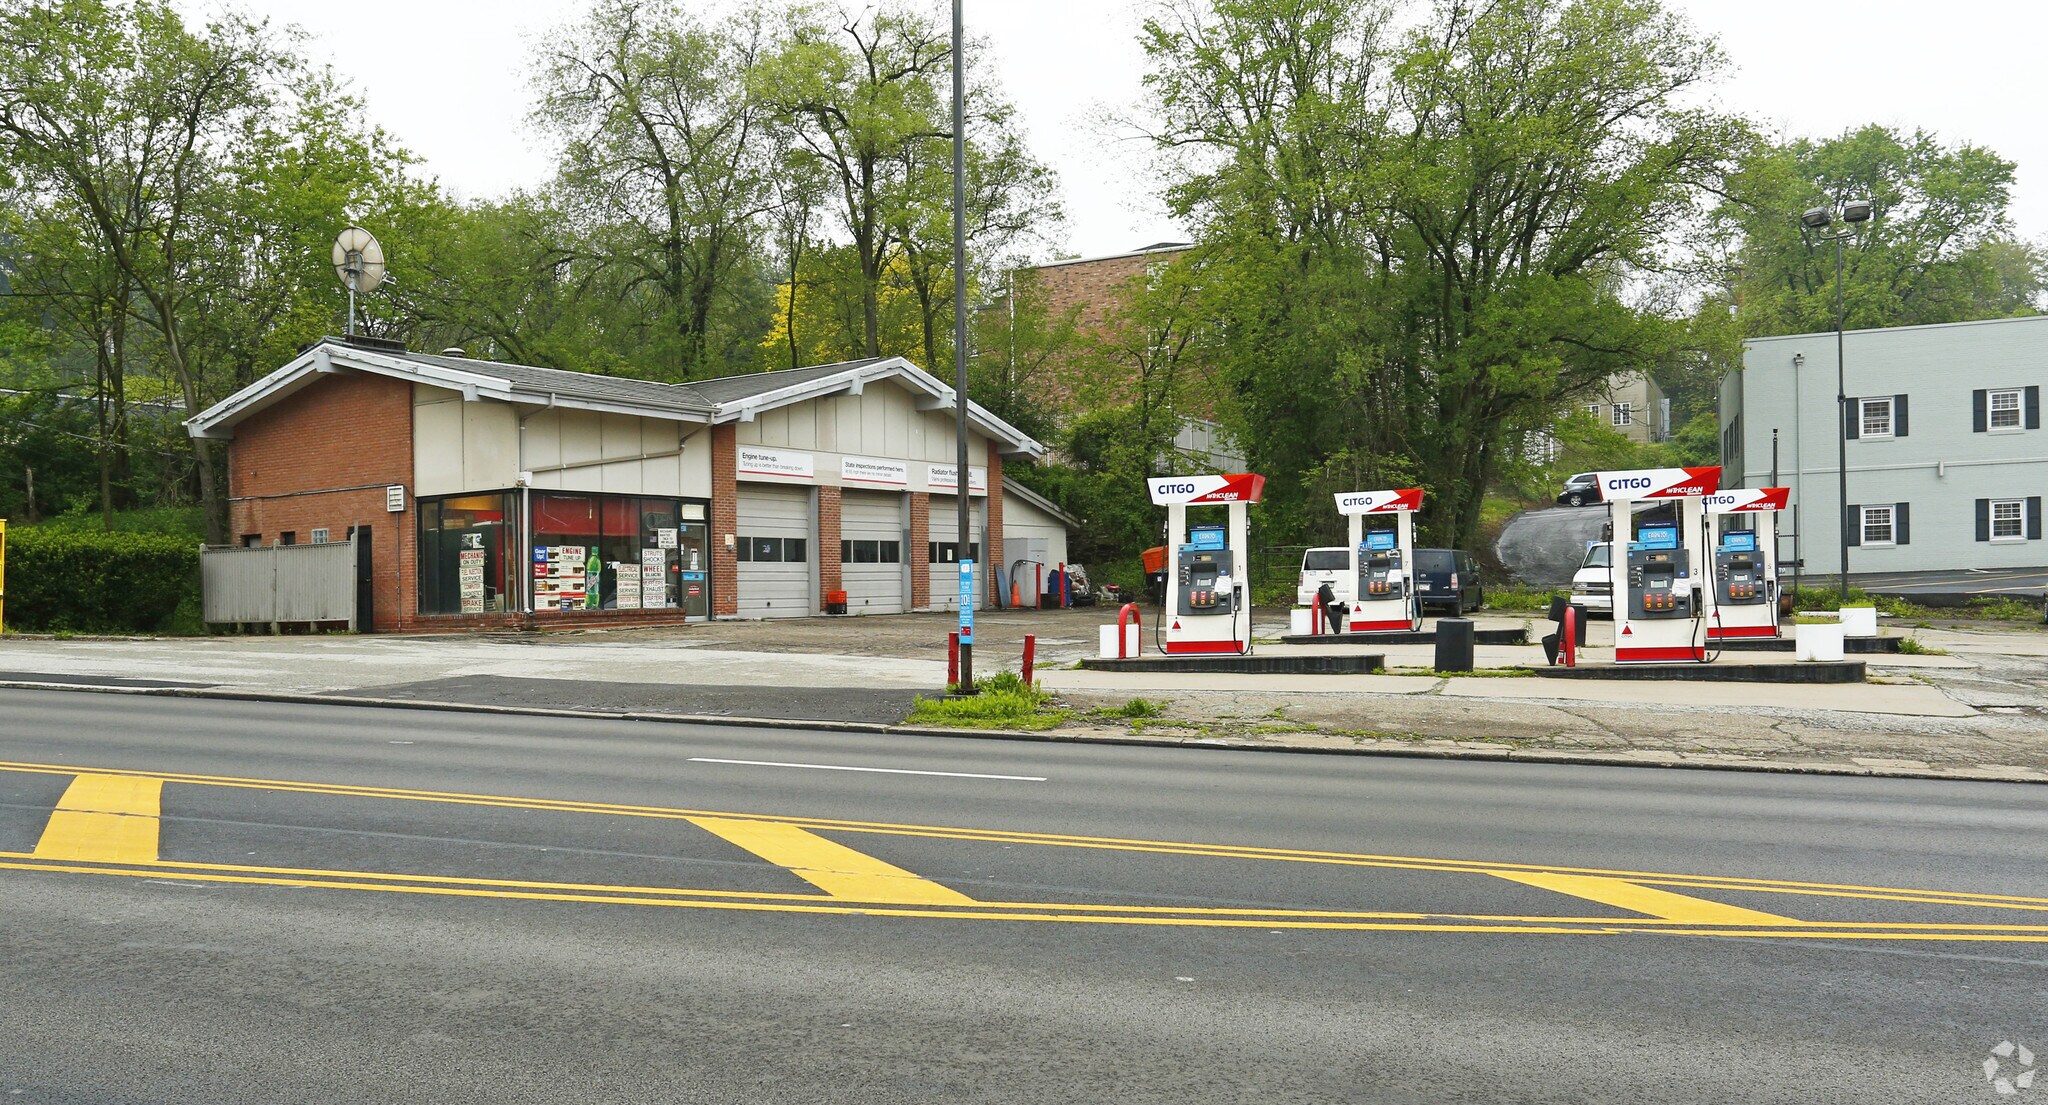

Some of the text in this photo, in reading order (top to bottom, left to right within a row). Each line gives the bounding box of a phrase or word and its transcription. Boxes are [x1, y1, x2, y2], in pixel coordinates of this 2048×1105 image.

[742, 452, 758, 460] Engine
[1609, 477, 1651, 490] CITGO
[1158, 484, 1195, 494] CITGO
[1343, 497, 1373, 506] CITGO
[1702, 496, 1735, 504] CITGO
